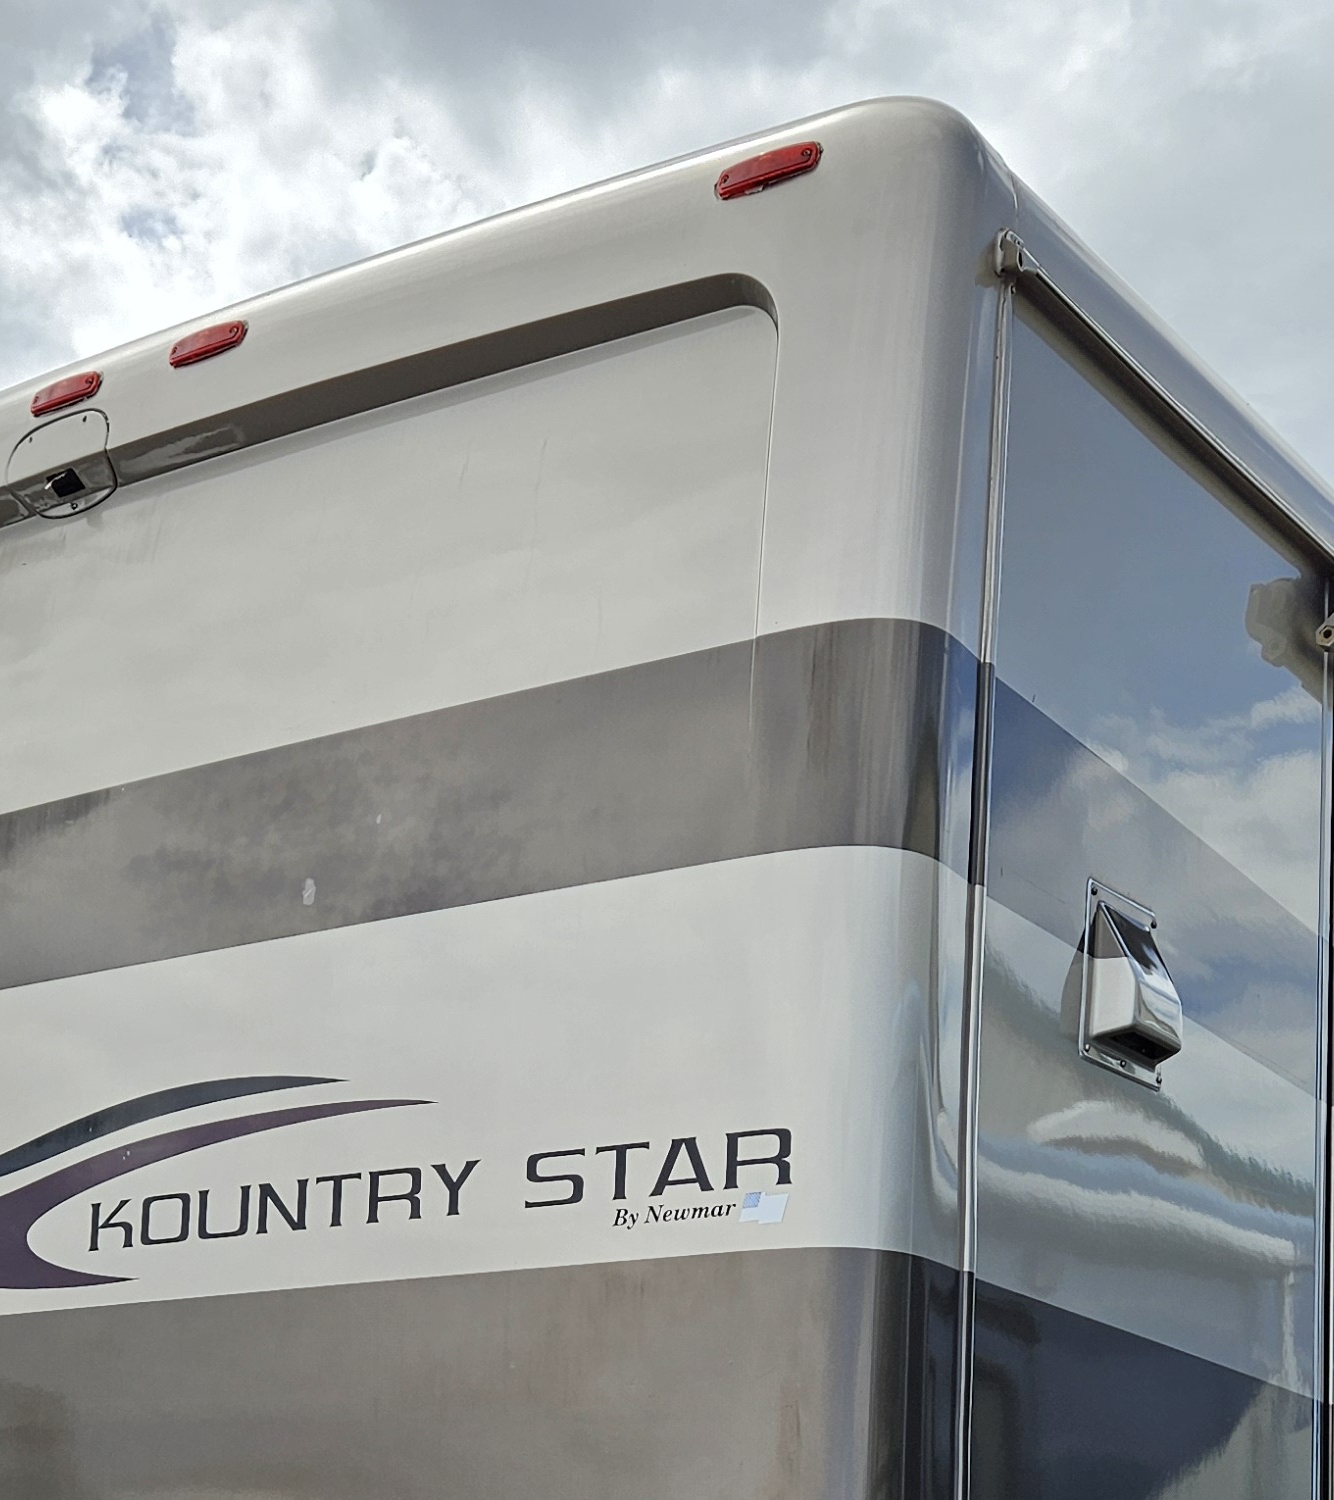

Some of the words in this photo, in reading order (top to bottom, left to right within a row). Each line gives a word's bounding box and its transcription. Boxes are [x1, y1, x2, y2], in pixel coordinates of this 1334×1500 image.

[87, 1159, 483, 1253] KOUNTRY
[523, 1127, 794, 1210] STAR
[612, 1208, 639, 1230] By
[643, 1203, 737, 1224] Newmar
